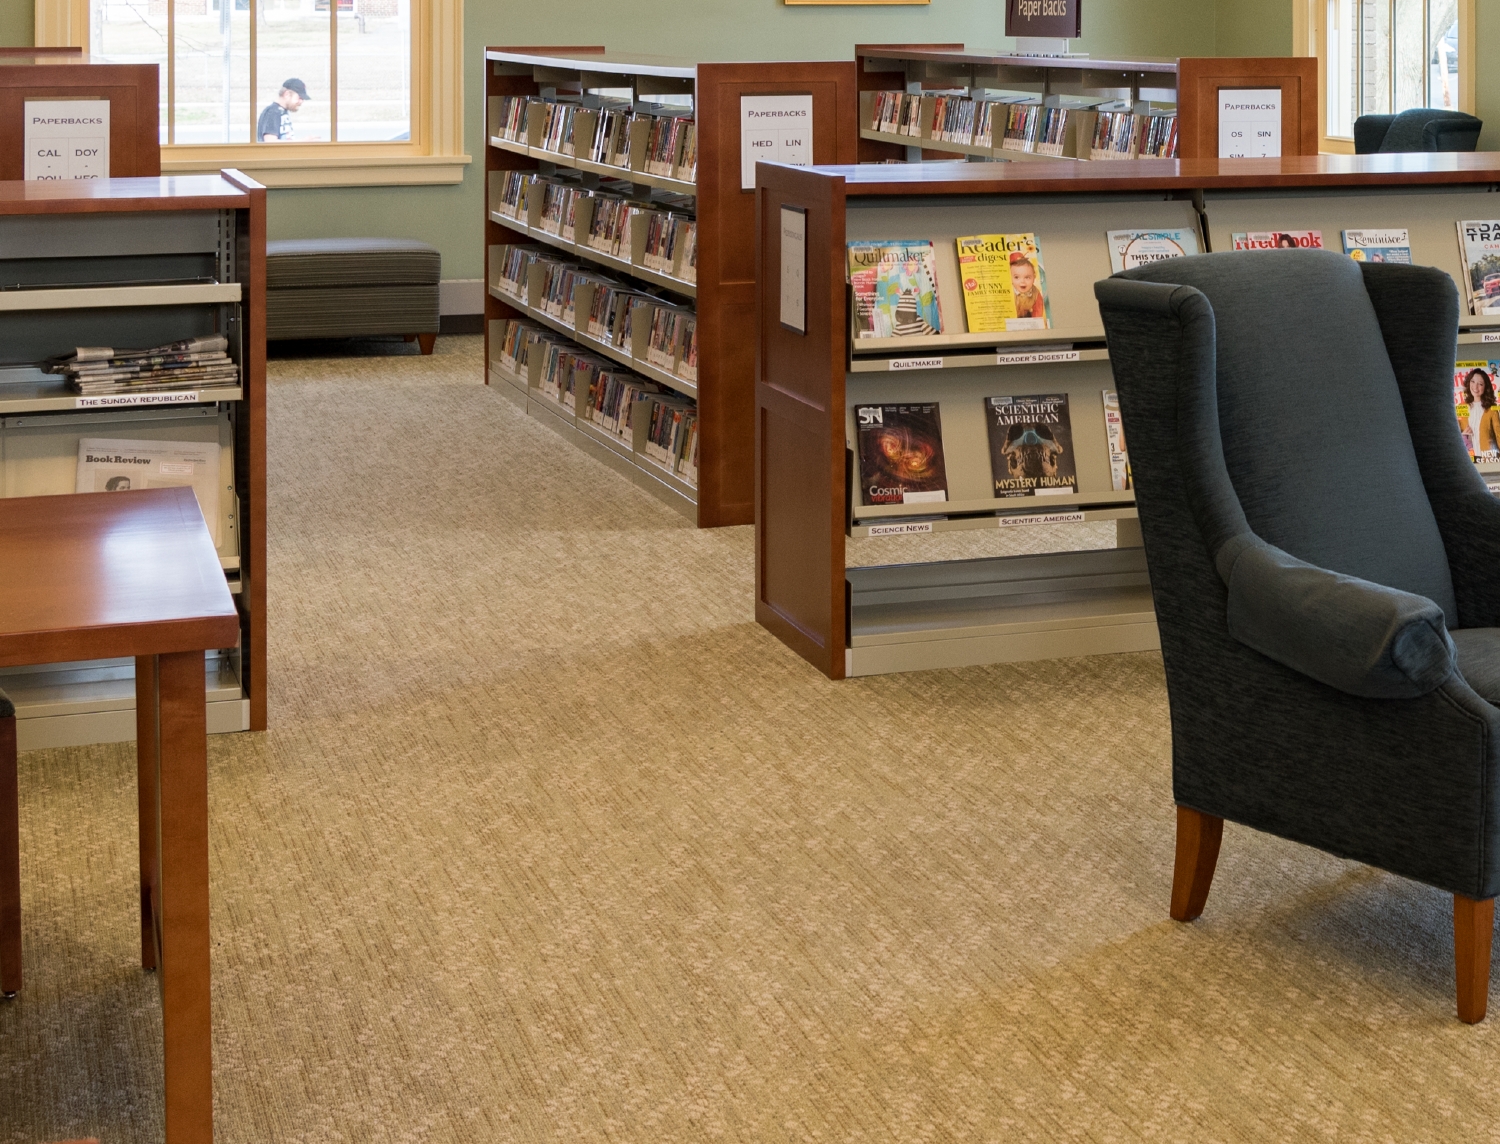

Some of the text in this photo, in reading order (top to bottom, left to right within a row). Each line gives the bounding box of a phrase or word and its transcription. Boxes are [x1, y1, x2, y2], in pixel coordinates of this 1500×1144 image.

[748, 110, 807, 118] PAPERBACKS
[32, 117, 103, 125] PAPERBACKS
[785, 139, 802, 147] LIN
[37, 149, 98, 157] CAL DOY
[1148, 232, 1181, 241] SIMPLE
[961, 237, 1034, 255] Reader's
[854, 247, 926, 267] Quiltmaker
[977, 253, 1008, 264] digest
[978, 282, 1004, 291] FUNNY
[1000, 355, 1037, 363] READER'S
[1038, 354, 1064, 362] DIGEST
[892, 359, 942, 368] QUILTMAKER
[100, 396, 138, 405] SUNDAY
[140, 394, 196, 403] REPUBLICAN
[995, 403, 1059, 416] SCIENTIFIC
[996, 413, 1060, 426] AMERICAN
[85, 455, 151, 465] Book Review
[995, 475, 1076, 490] MYSTERY HUMAN
[1001, 514, 1082, 525] SCIENTIFIC AMERICAN
[871, 526, 904, 535] SCIENCE
